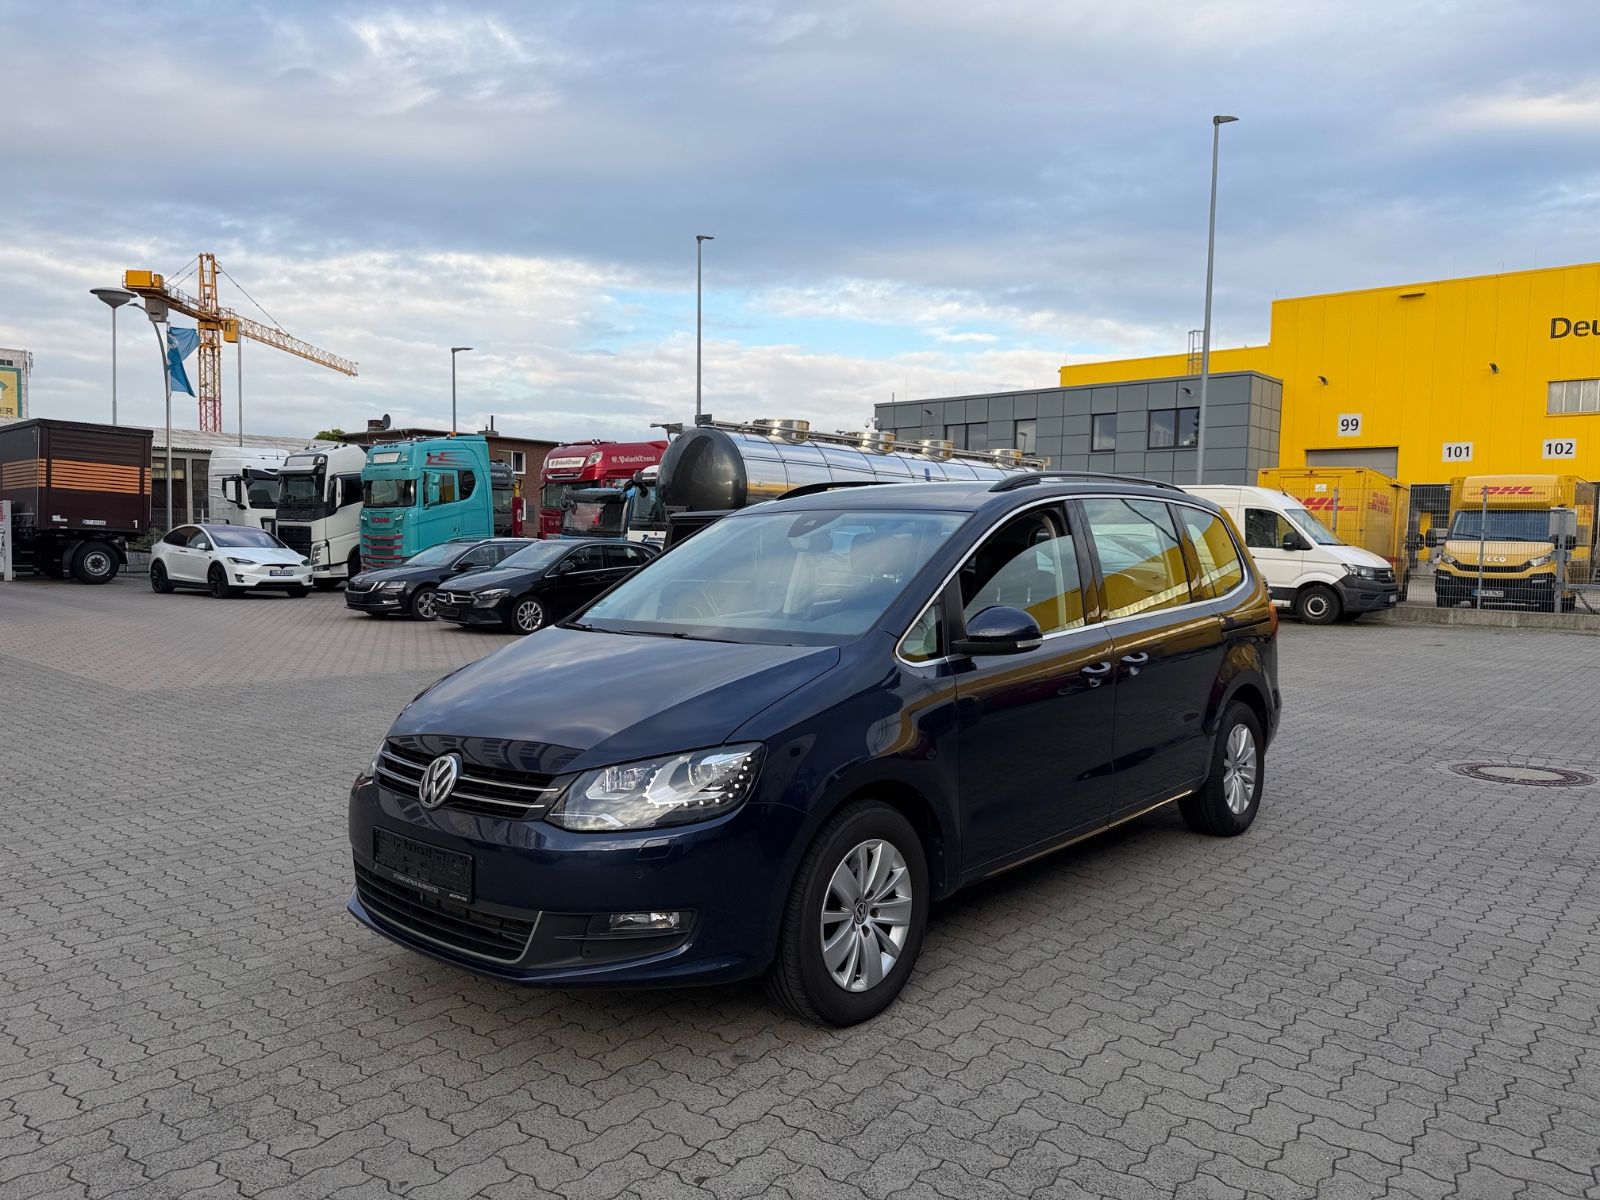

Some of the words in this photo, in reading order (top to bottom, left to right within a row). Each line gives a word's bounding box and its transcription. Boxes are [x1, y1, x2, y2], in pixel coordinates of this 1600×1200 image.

[1341, 418, 1359, 432] 99
[1446, 445, 1471, 458] 101
[1545, 442, 1574, 456] 102
[1480, 486, 1534, 496] DHL
[132, 519, 138, 529] 1
